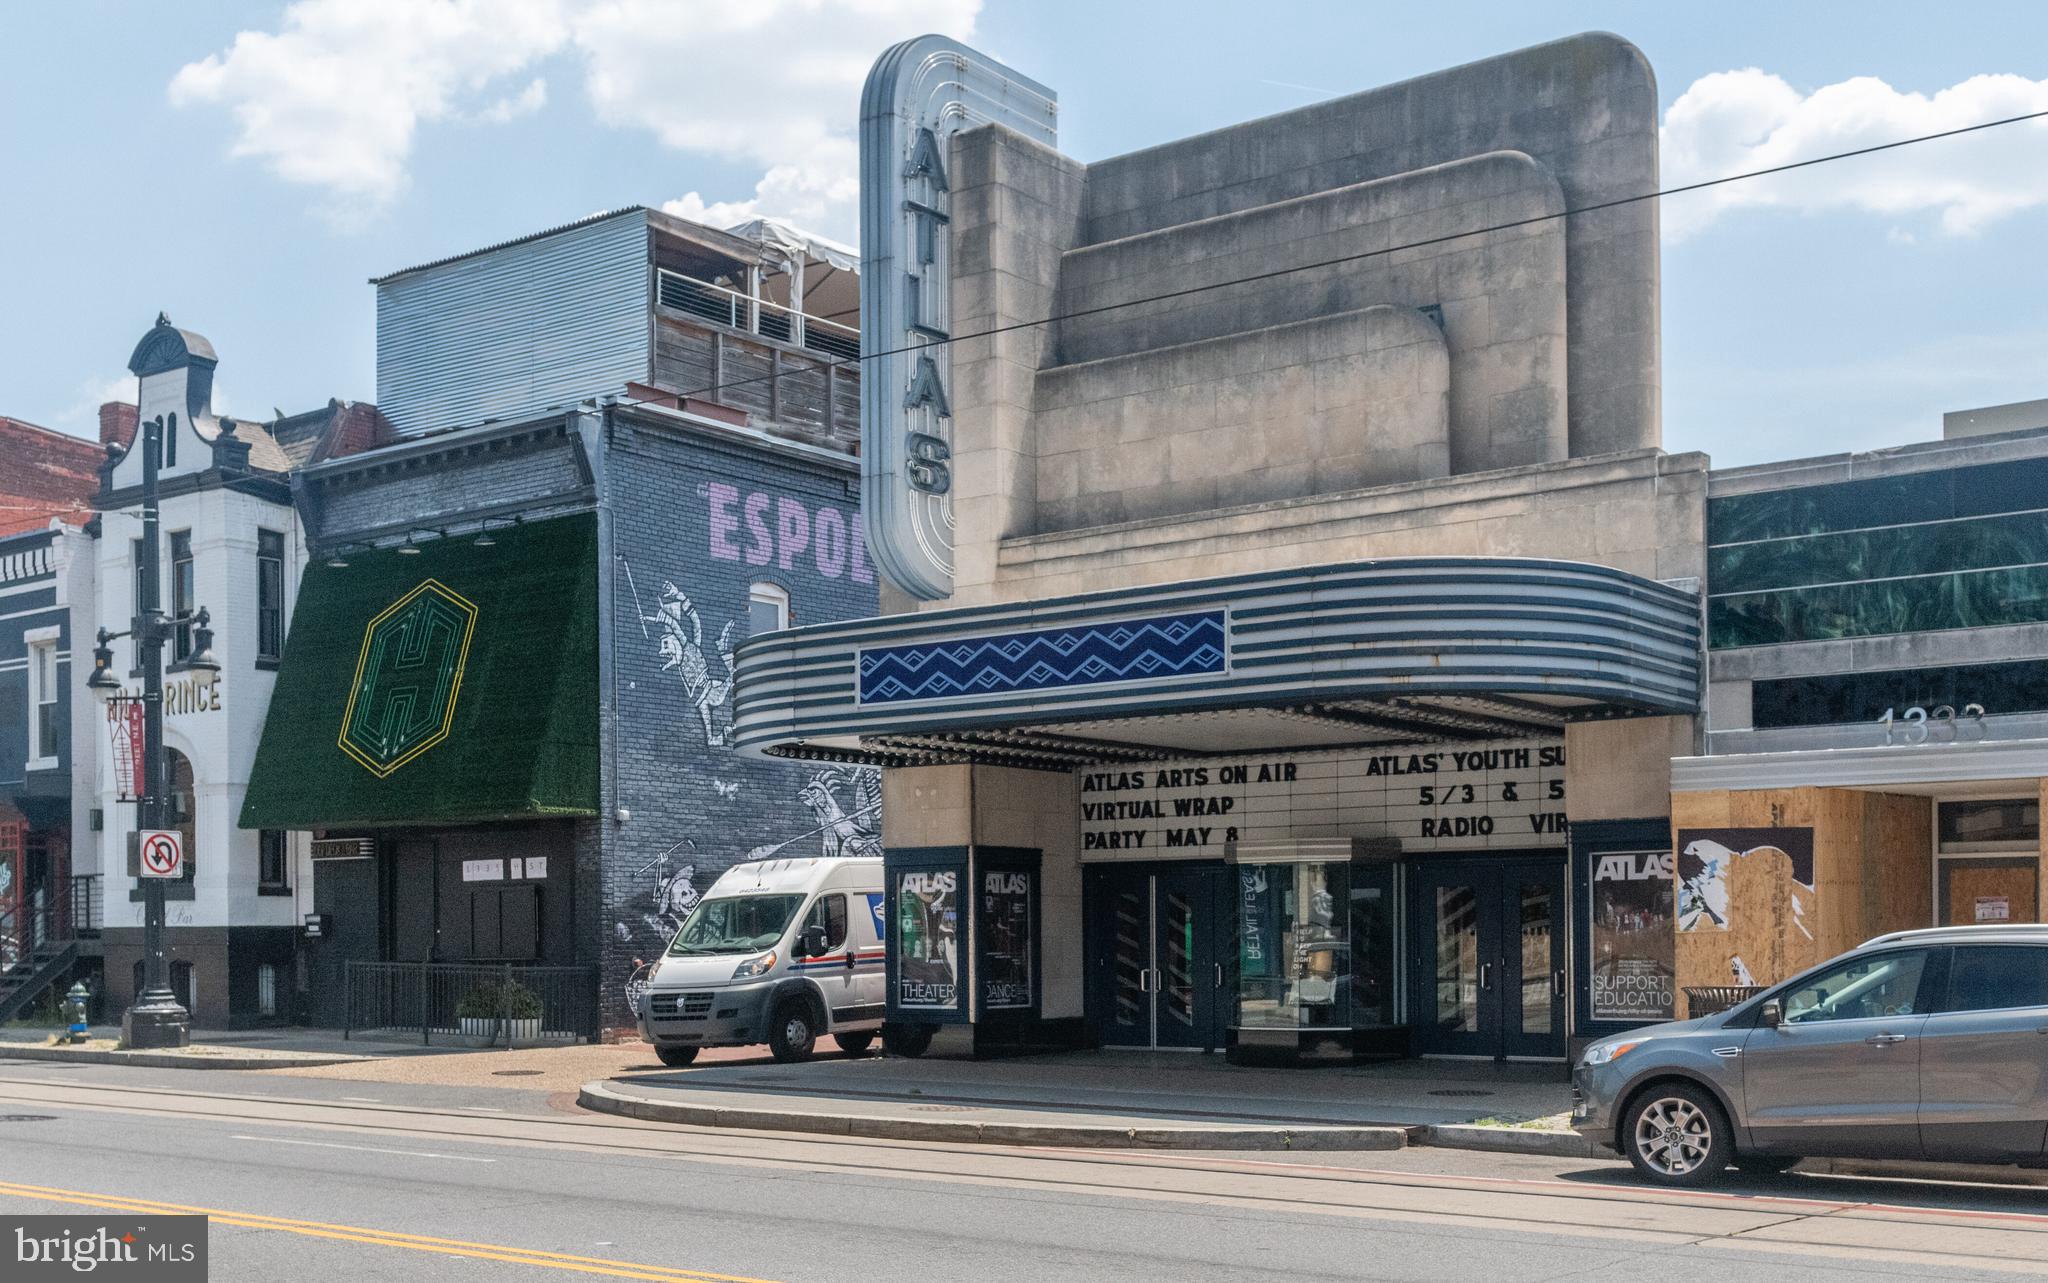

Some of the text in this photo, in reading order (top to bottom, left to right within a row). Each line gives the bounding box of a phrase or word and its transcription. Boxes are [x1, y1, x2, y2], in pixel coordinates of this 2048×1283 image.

[902, 127, 951, 495] ATLAS
[708, 481, 874, 585] ESPOL
[164, 676, 221, 716] RINCE
[1366, 746, 1566, 776] ATLAS' YOUTH SU
[1083, 762, 1297, 792] ATLAS ARTS ON AIR
[1502, 781, 1519, 802] &
[1082, 796, 1235, 820] VIRTUAL WRAP
[1421, 813, 1568, 837] RADIO VIR
[1084, 826, 1239, 850] PARTY MAY 8
[1594, 853, 1673, 881] ATLAS
[901, 872, 957, 893] ATLAS
[985, 873, 1027, 894] ATLAS
[902, 984, 955, 998] THEATER
[1594, 975, 1668, 990] SUPPORT
[1594, 991, 1673, 1006] EDUCATIO
